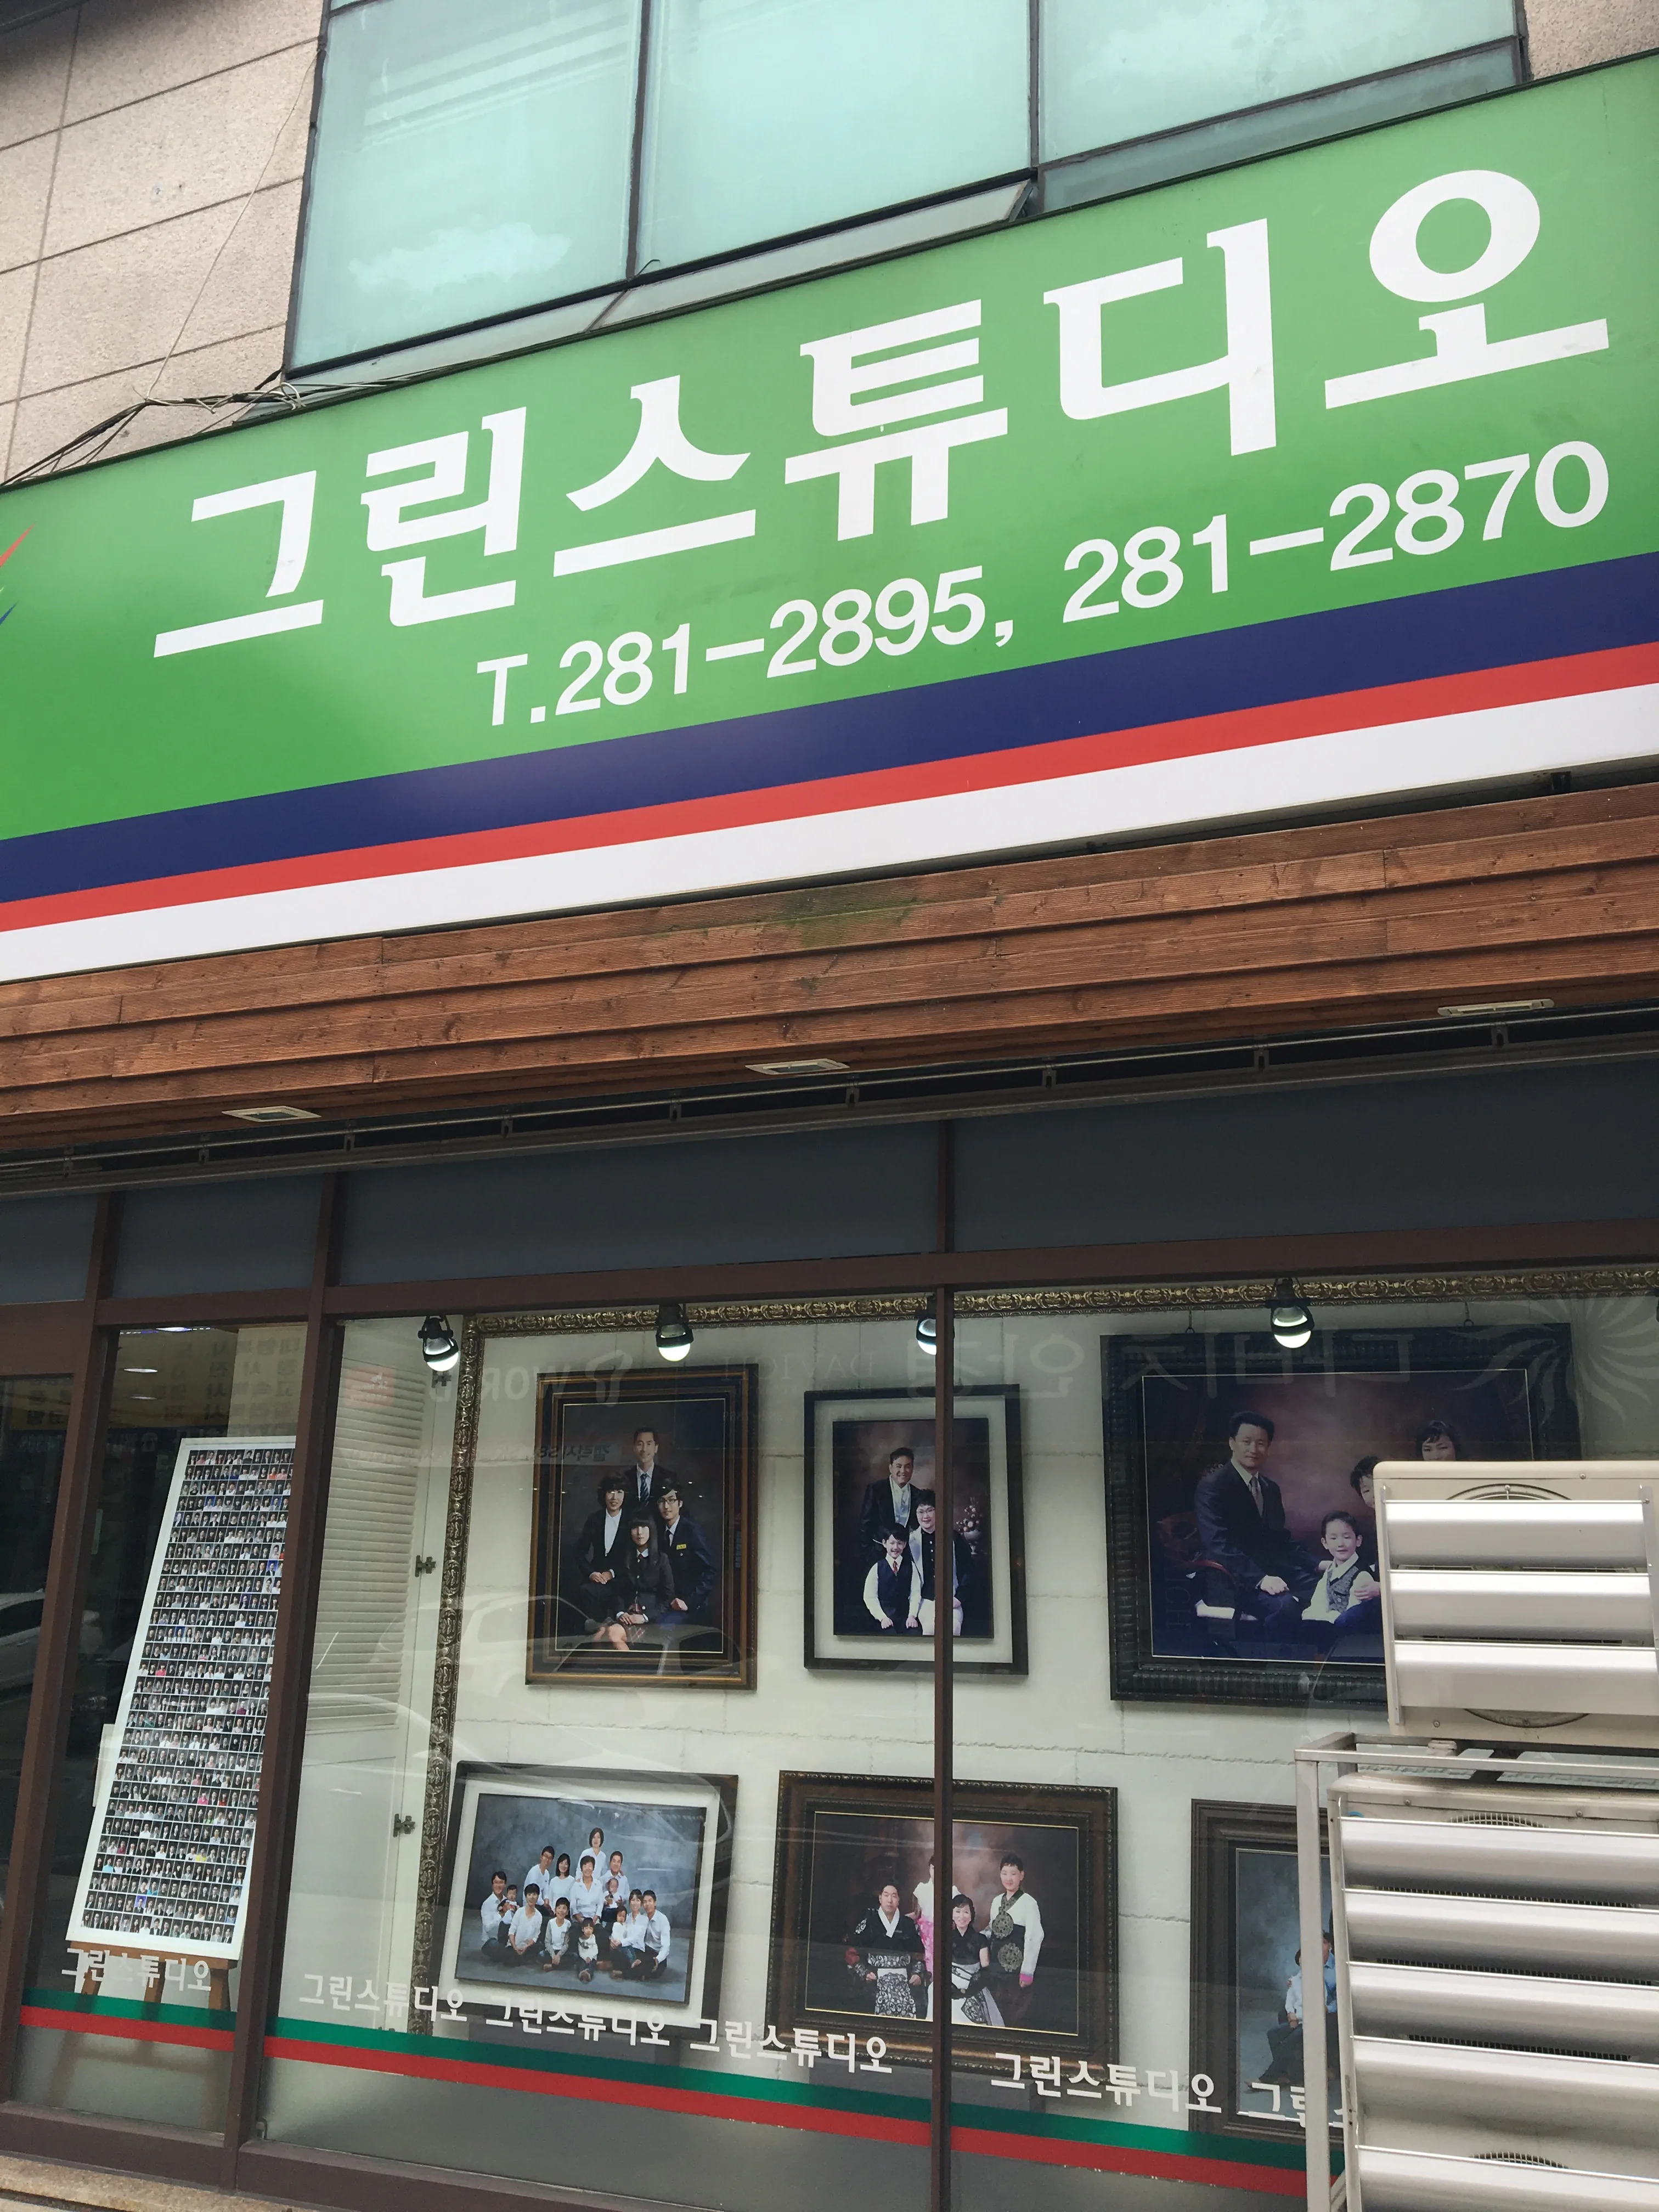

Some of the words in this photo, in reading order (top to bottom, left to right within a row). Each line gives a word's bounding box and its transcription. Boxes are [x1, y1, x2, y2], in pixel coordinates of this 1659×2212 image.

[153, 170, 1609, 658] 그린스튜디오
[1063, 441, 1609, 623] 281-2870
[61, 1948, 212, 1992] 그린스튜디오
[299, 1973, 467, 2023] 그린스튜디오
[486, 1994, 670, 2046] 그린스튜디오
[689, 2018, 893, 2074] 그린스튜디오
[990, 2052, 1222, 2114] 그린스튜디오
